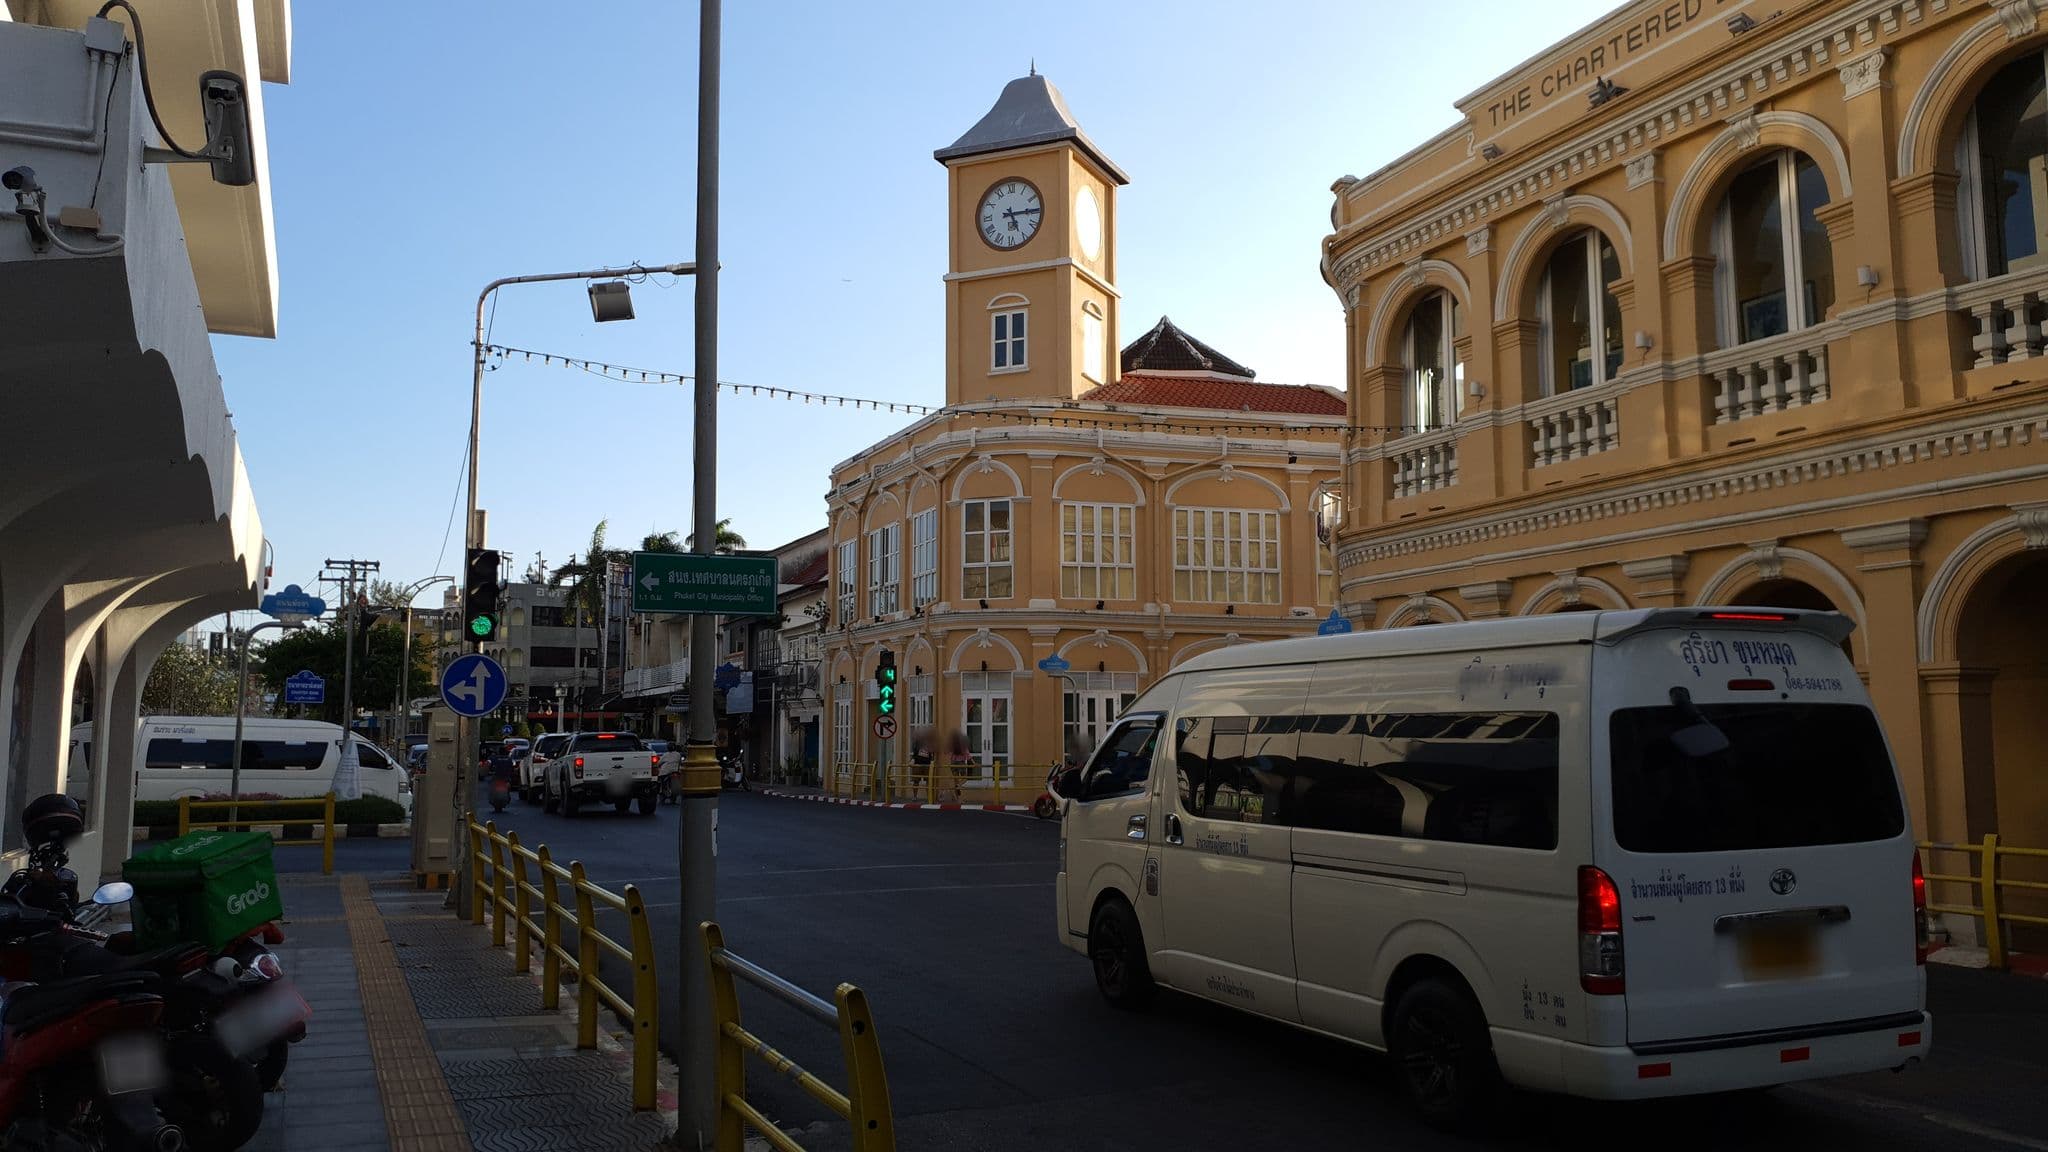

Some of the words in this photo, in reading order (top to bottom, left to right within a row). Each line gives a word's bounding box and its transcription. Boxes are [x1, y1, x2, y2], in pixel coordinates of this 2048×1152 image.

[1488, 87, 1532, 127] THE
[1541, 0, 1702, 97] CHARTERED
[668, 568, 772, 593] สนง.เทศบาลนครภูเก็ต
[674, 592, 695, 600] Phuket
[697, 592, 709, 602] City
[710, 593, 745, 602] Municipality
[747, 594, 764, 602] Office
[1680, 631, 1729, 677] สุริยา
[886, 669, 895, 681] 4
[171, 833, 224, 856] Grab
[226, 880, 270, 915] Grab
[1715, 878, 1726, 894] 13
[1538, 991, 1548, 1005] 13
